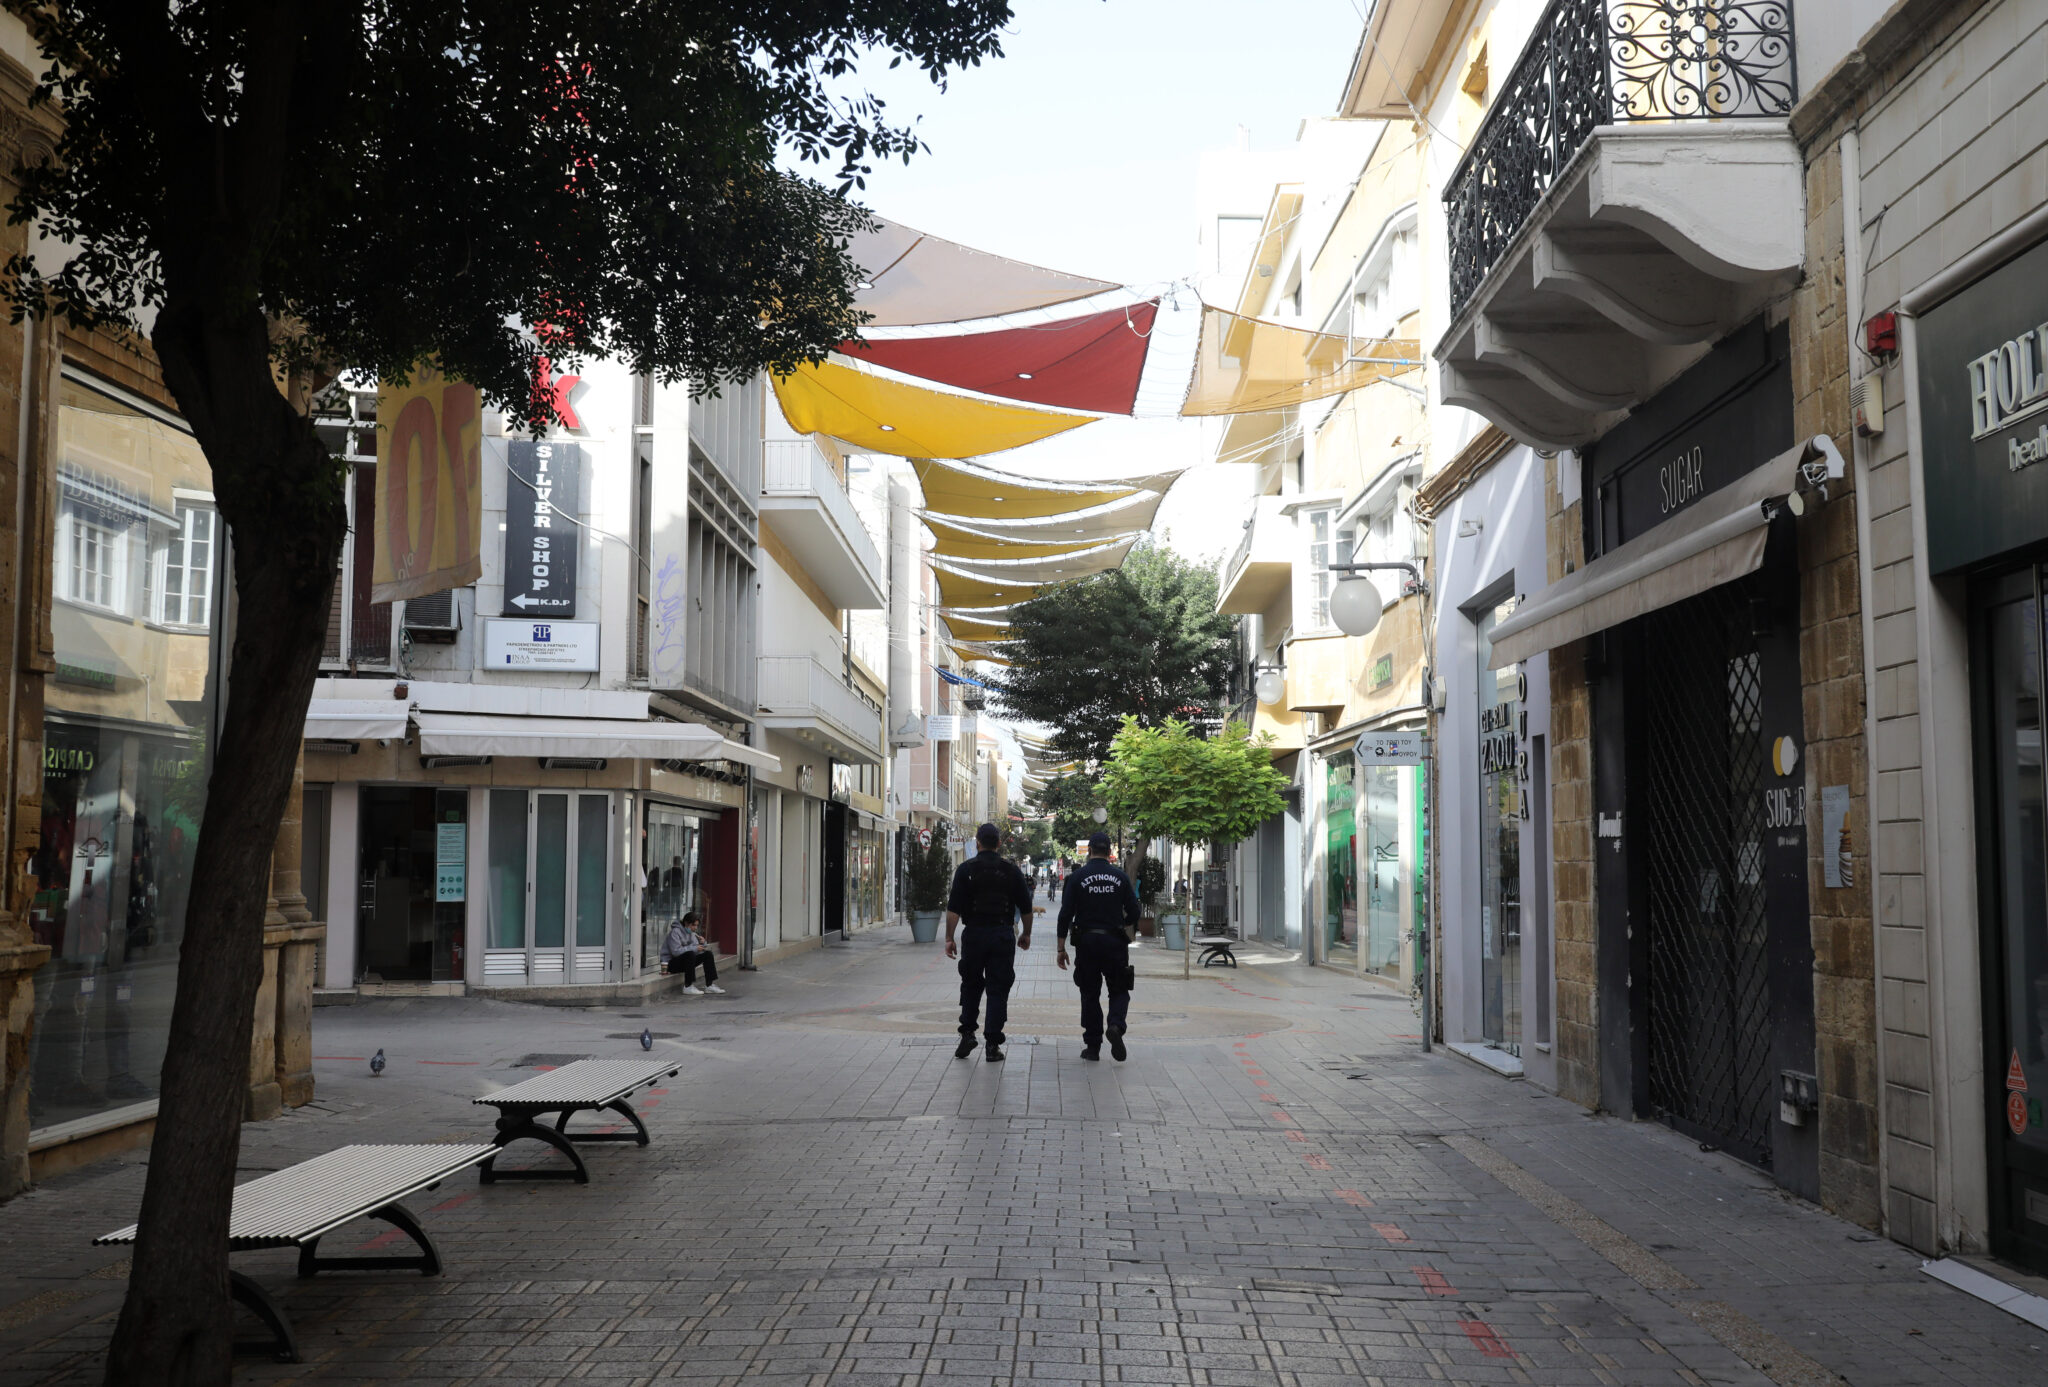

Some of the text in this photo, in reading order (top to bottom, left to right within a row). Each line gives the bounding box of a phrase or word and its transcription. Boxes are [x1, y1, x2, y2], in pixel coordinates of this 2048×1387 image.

[2009, 425, 2048, 472] heal
[1661, 446, 1704, 514] SUGAR
[532, 446, 552, 591] SILVER SHOP
[1766, 786, 1806, 828] SUGR
[1080, 873, 1122, 889] ΑΣΤΥΝΟΜΙΑ
[1088, 885, 1115, 894] POLICE
